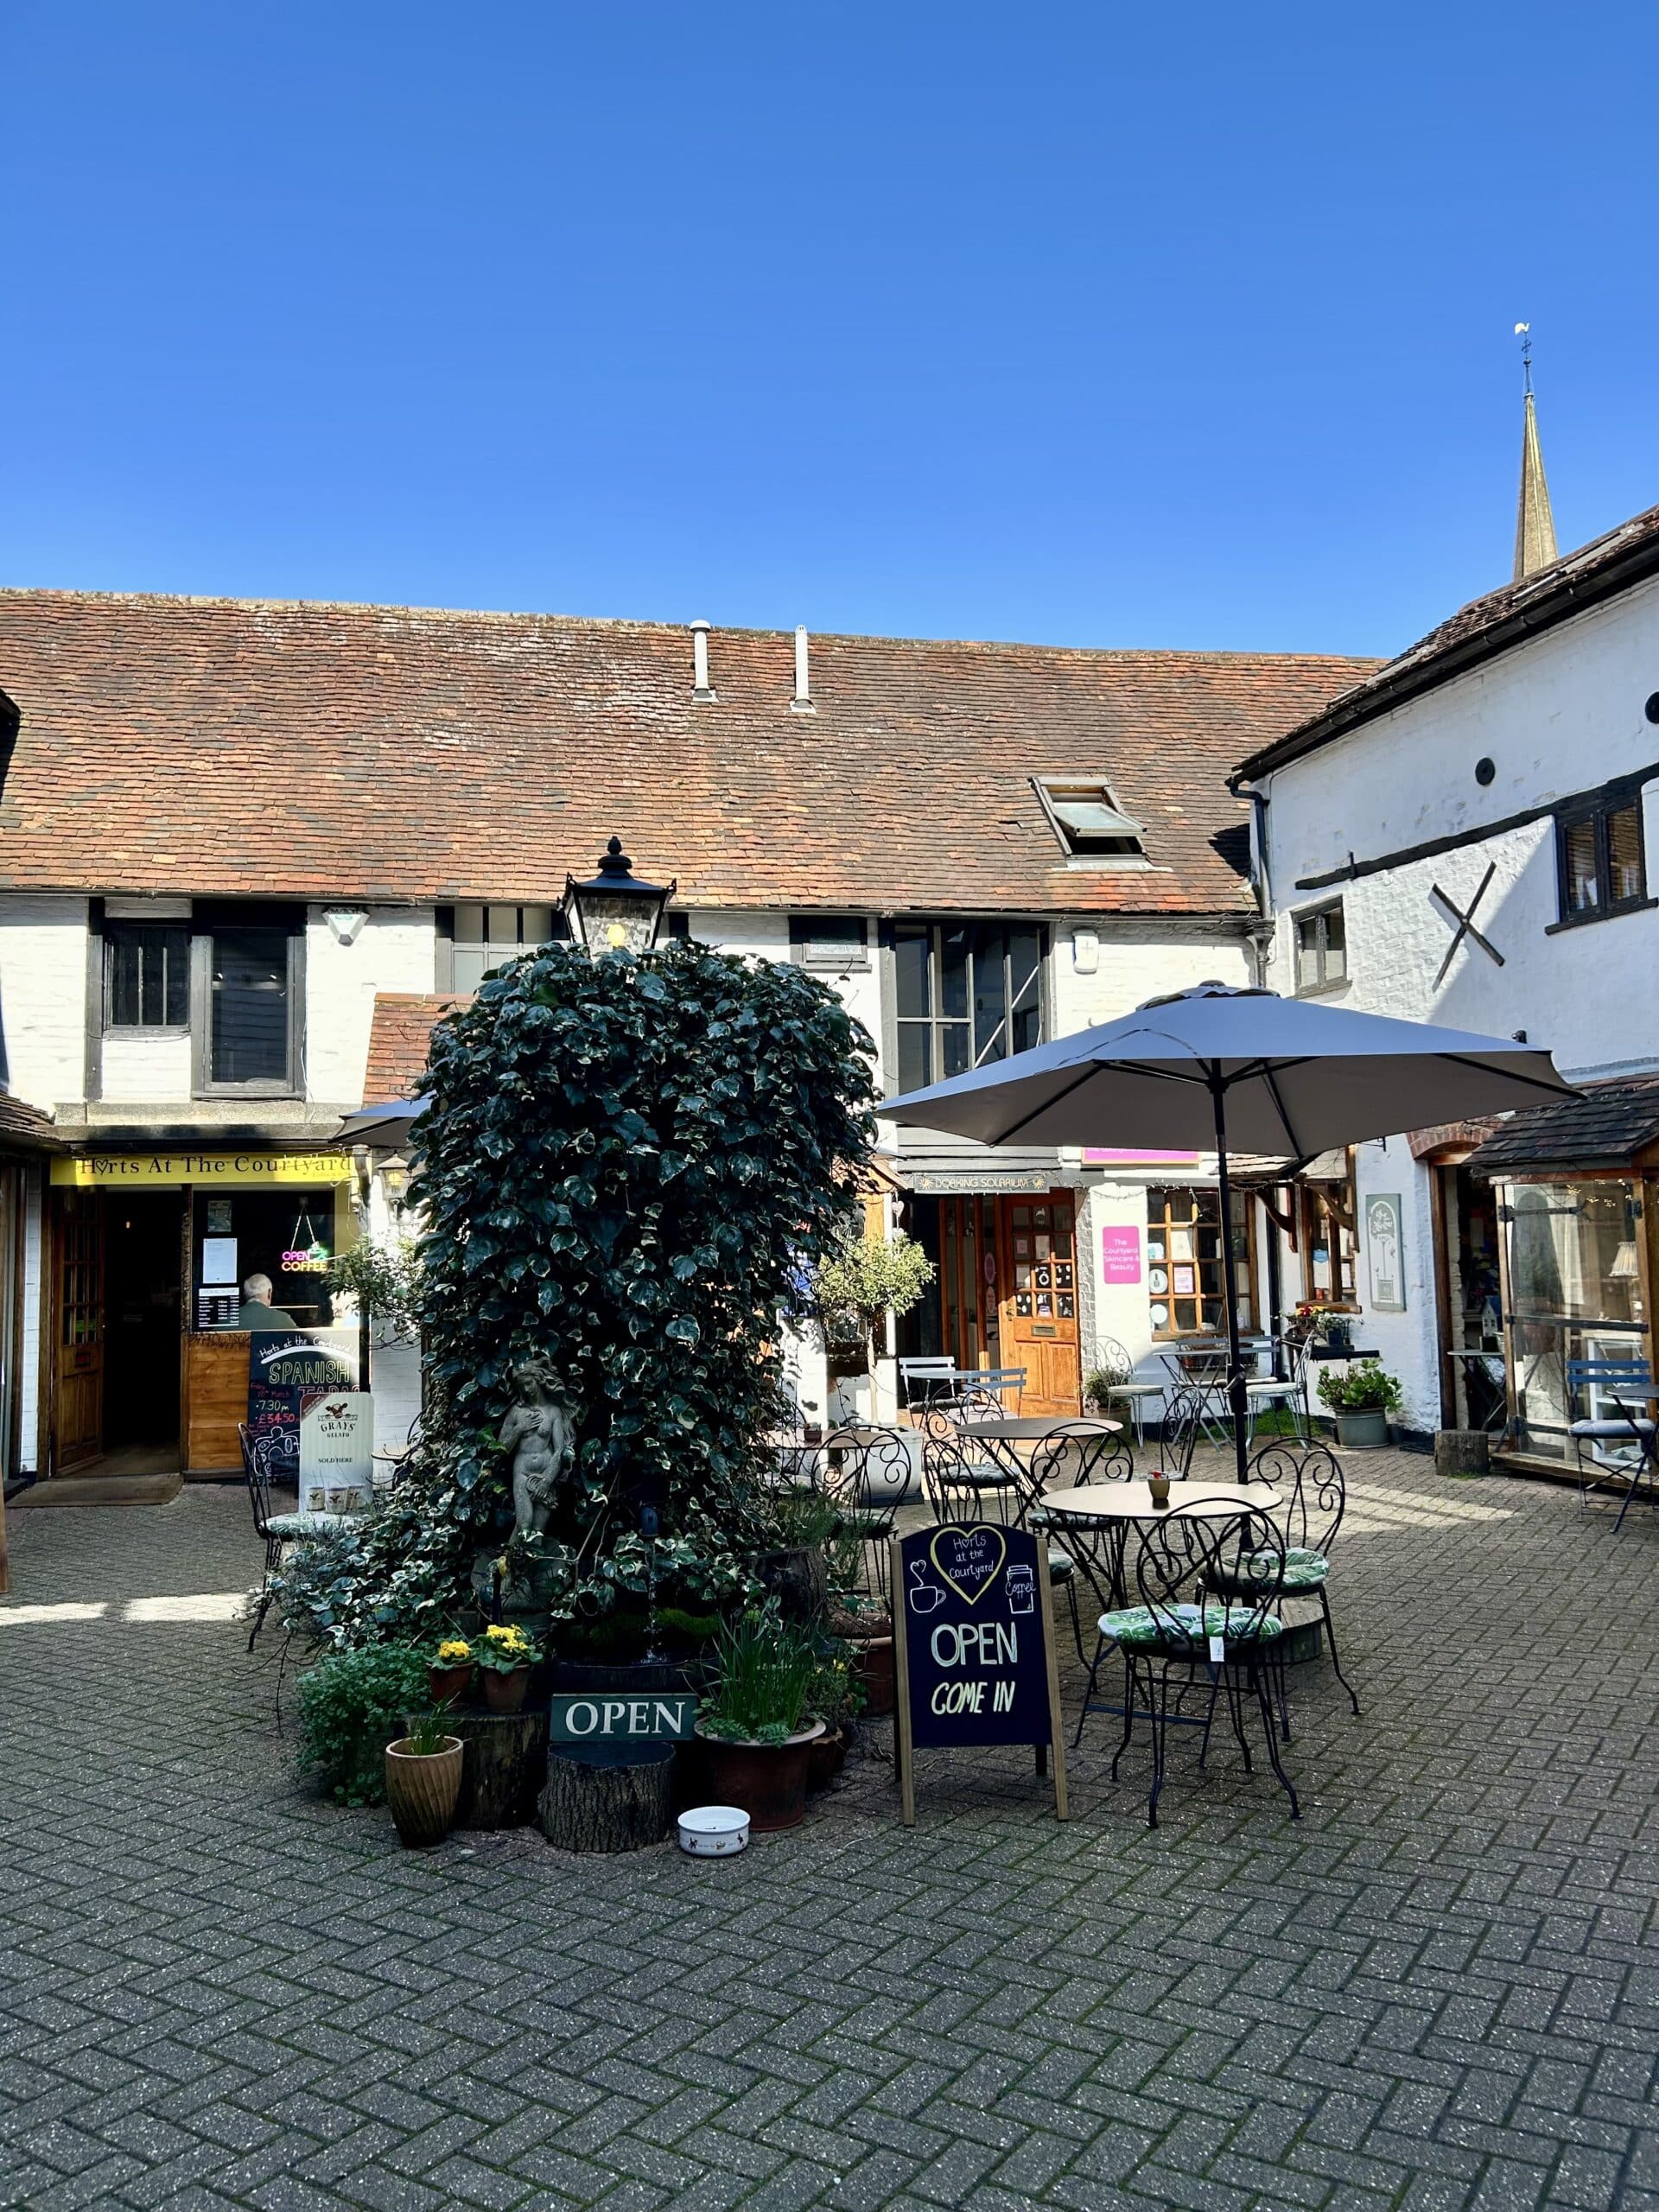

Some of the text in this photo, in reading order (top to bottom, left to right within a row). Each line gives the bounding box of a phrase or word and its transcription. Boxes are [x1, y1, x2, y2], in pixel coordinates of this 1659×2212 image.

[148, 1157, 171, 1173] At
[181, 1156, 226, 1173] The
[234, 1156, 351, 1175] Courtyard
[935, 1176, 1028, 1188] DORKING SOLARIUM
[282, 1251, 309, 1262] OPEN
[1104, 1247, 1139, 1255] Courtyard
[281, 1262, 327, 1272] COFFEE
[283, 1337, 293, 1349] at
[295, 1334, 308, 1346] the
[269, 1360, 350, 1384] SPANISH
[956, 1549, 984, 1562] at the
[1005, 1581, 1036, 1599] Coffee
[931, 1621, 1018, 1668] OPEN
[931, 1681, 1015, 1715] COME IN
[565, 1701, 686, 1735] OPEN
